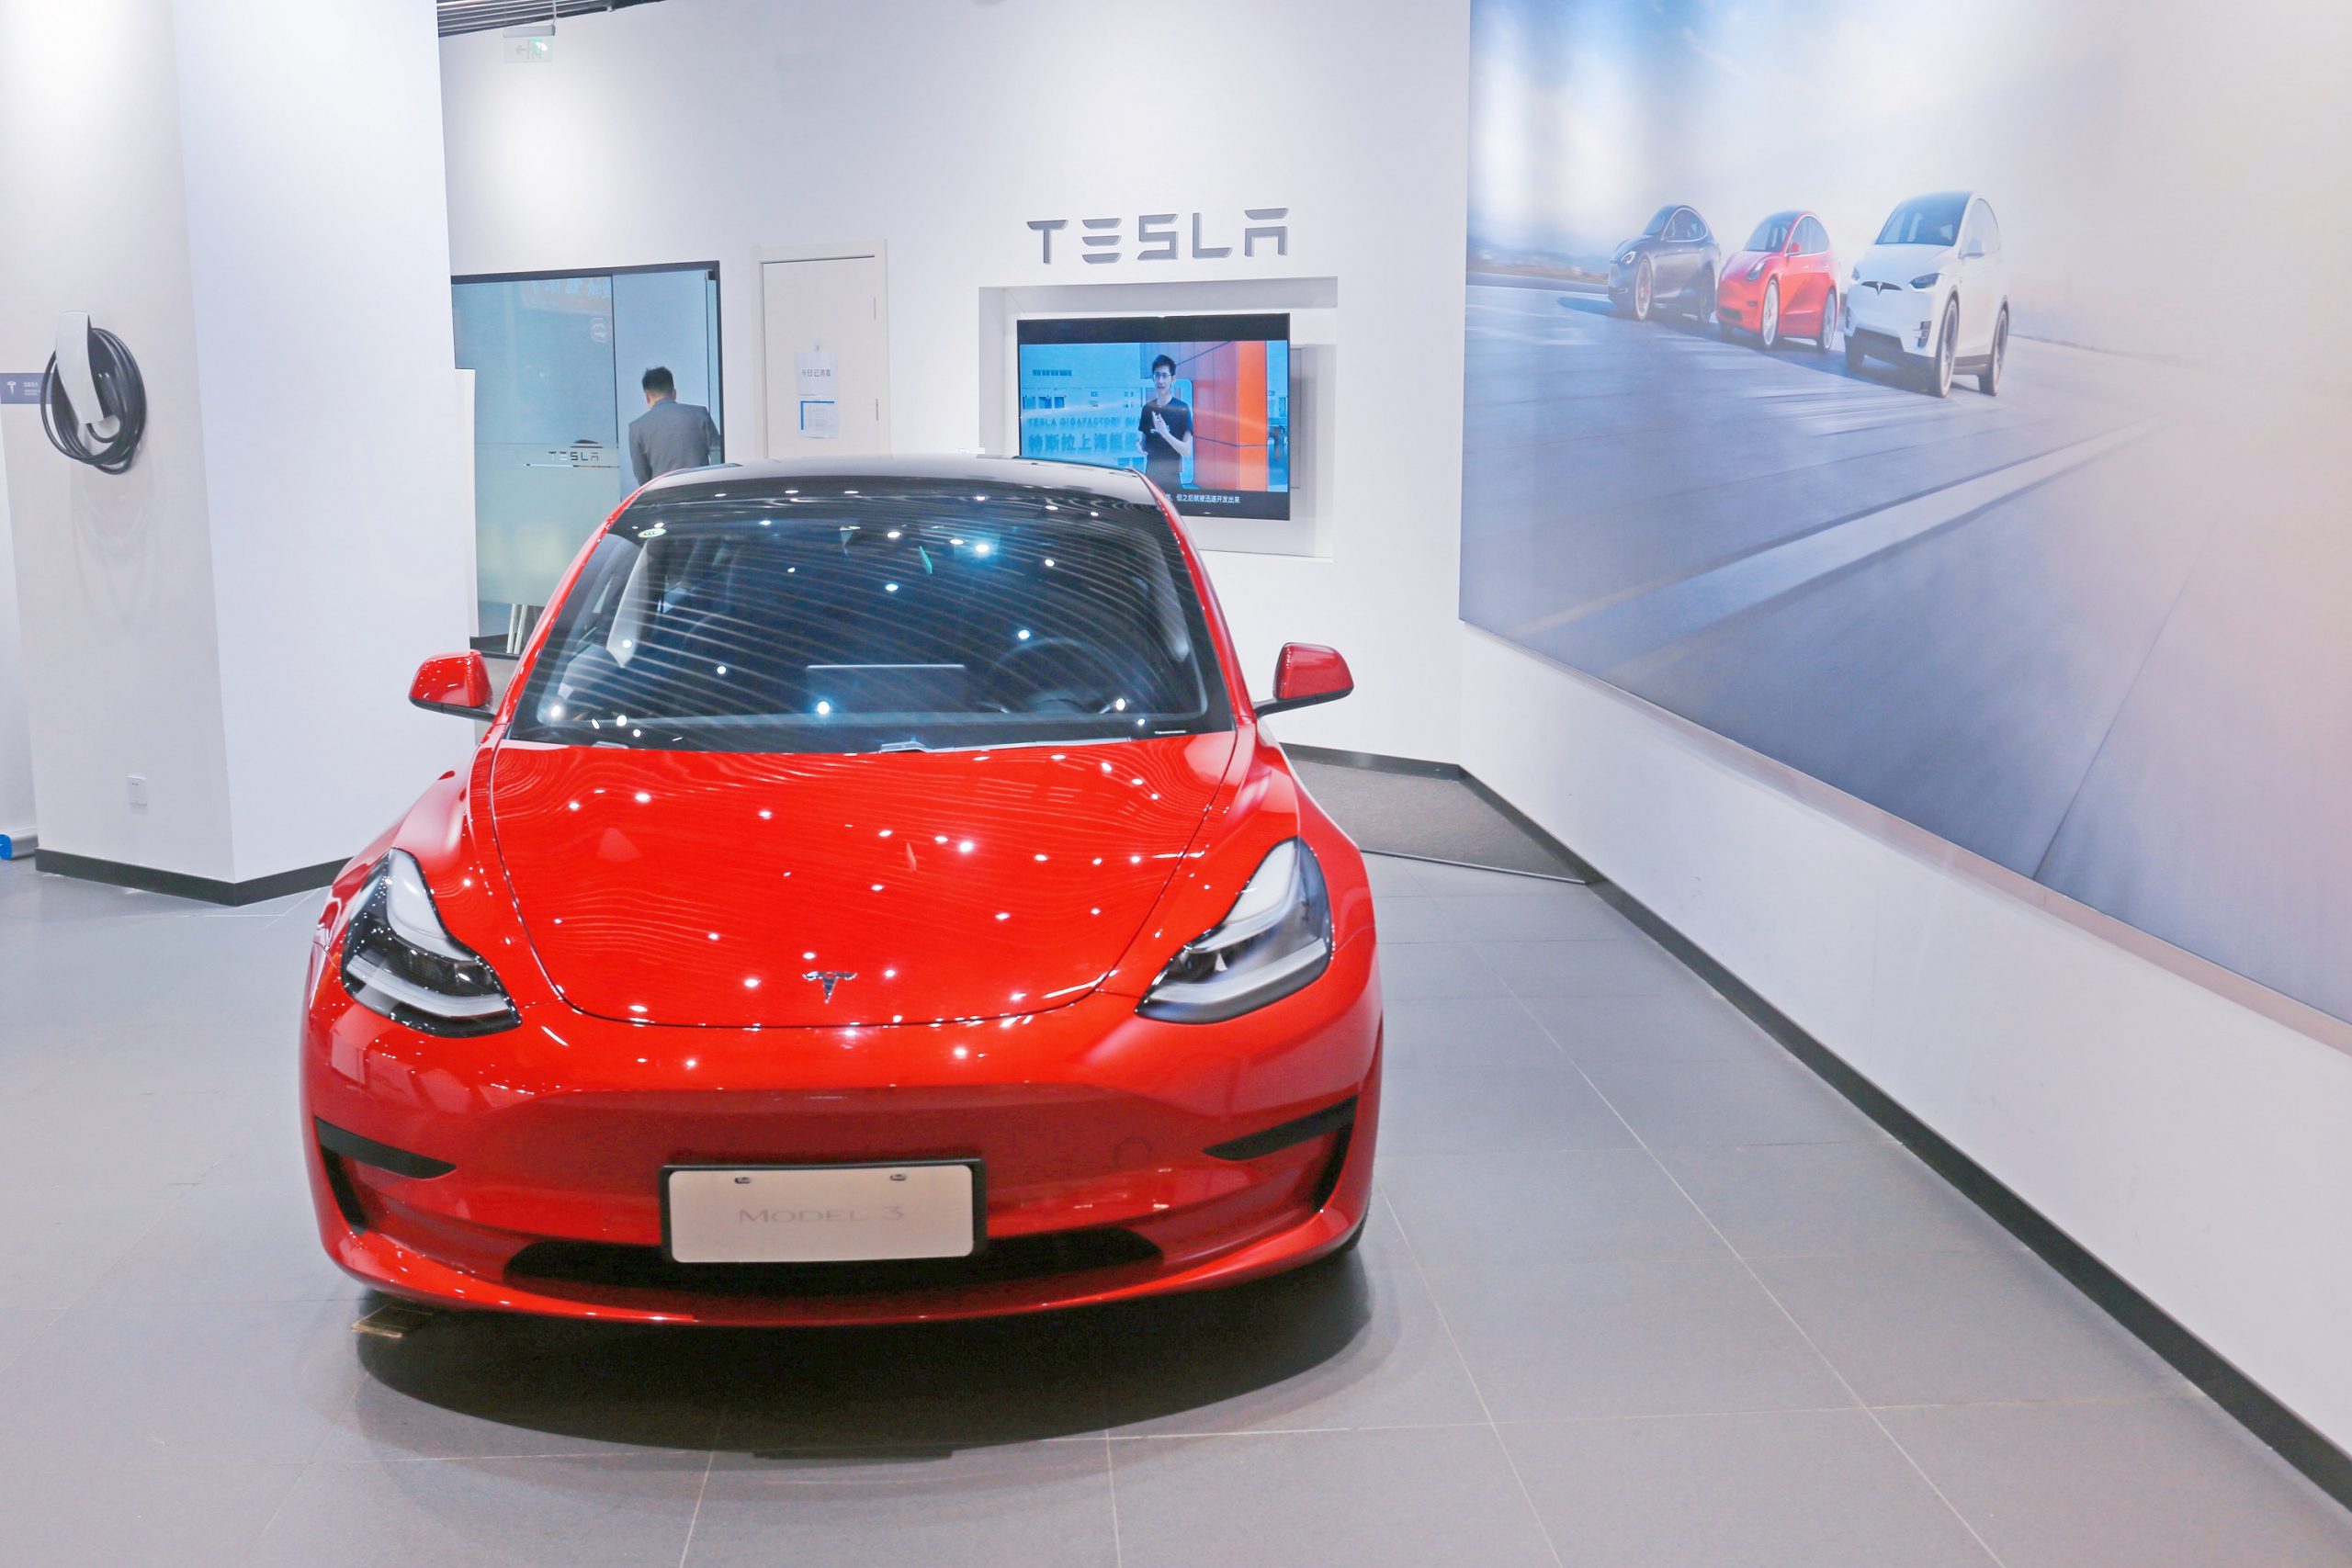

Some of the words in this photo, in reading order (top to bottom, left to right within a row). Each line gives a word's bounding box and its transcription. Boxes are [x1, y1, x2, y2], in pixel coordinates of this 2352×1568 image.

[1026, 208, 1289, 265] TESLA
[548, 451, 599, 462] TESLA
[881, 1204, 904, 1222] 3
